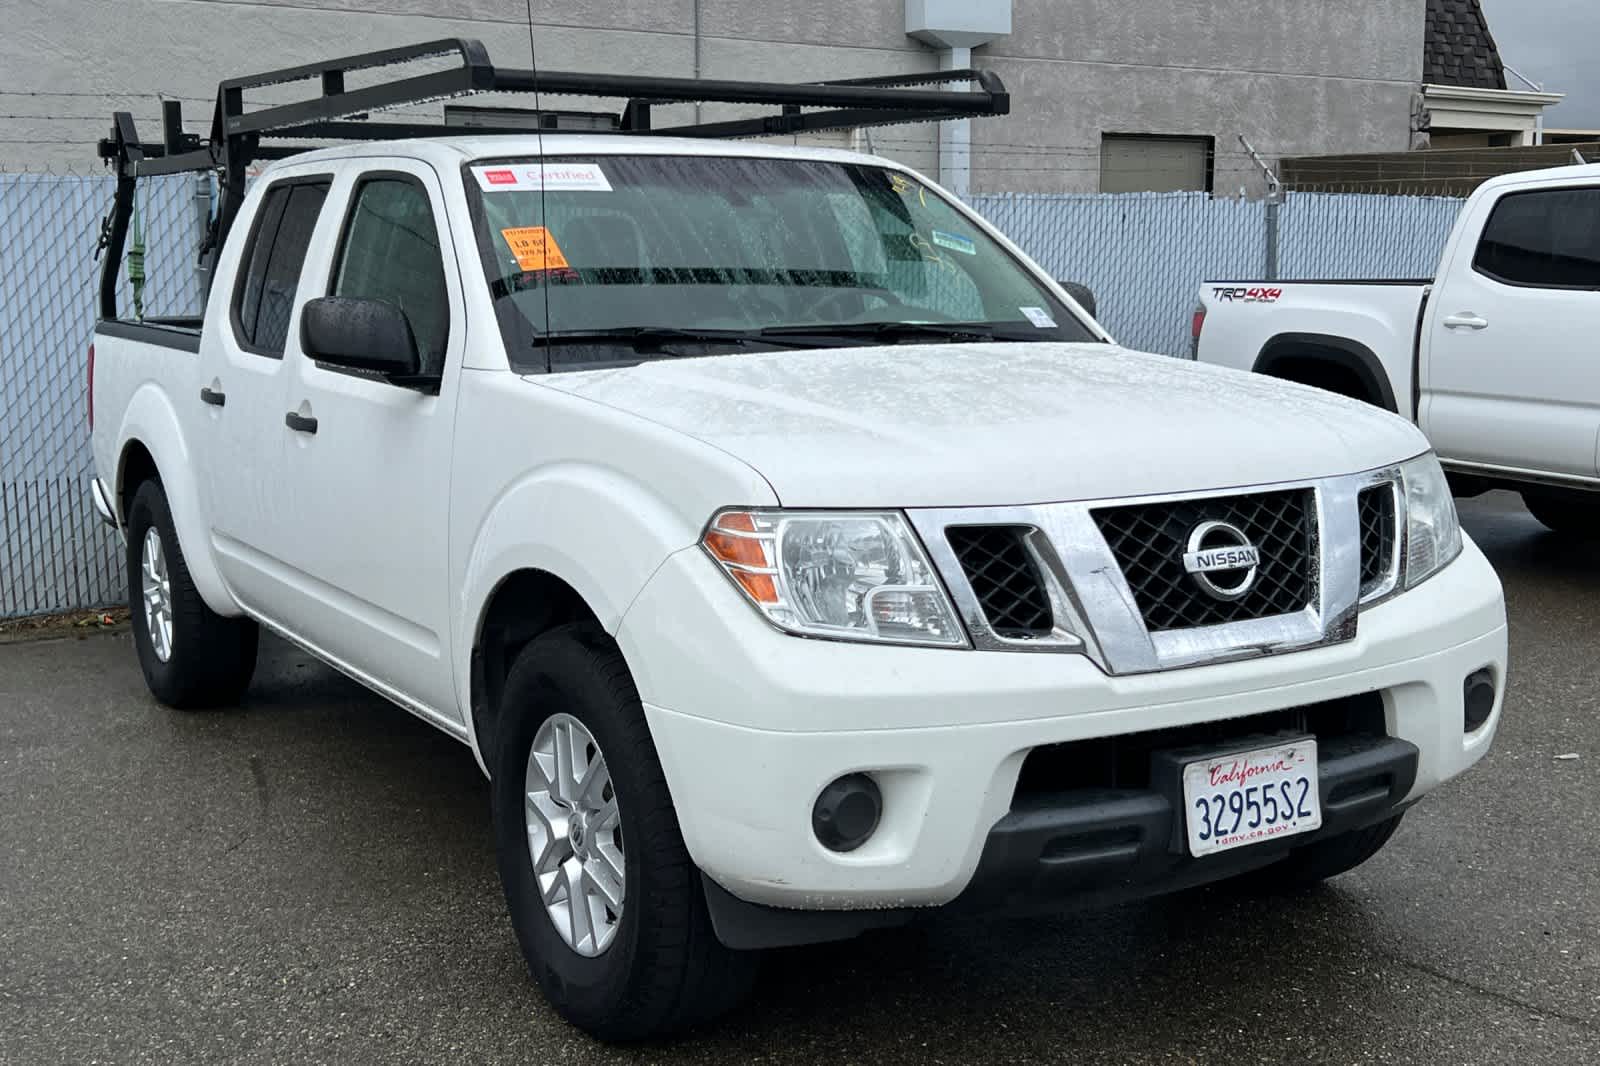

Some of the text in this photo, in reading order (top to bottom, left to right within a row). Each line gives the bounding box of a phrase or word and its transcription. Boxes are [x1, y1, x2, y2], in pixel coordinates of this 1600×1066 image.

[526, 169, 595, 181] Certified
[1196, 549, 1257, 568] NISSAN
[1210, 758, 1292, 787] California
[1195, 776, 1312, 841] 32955S2
[1221, 823, 1289, 845] dmv.ca.gov
